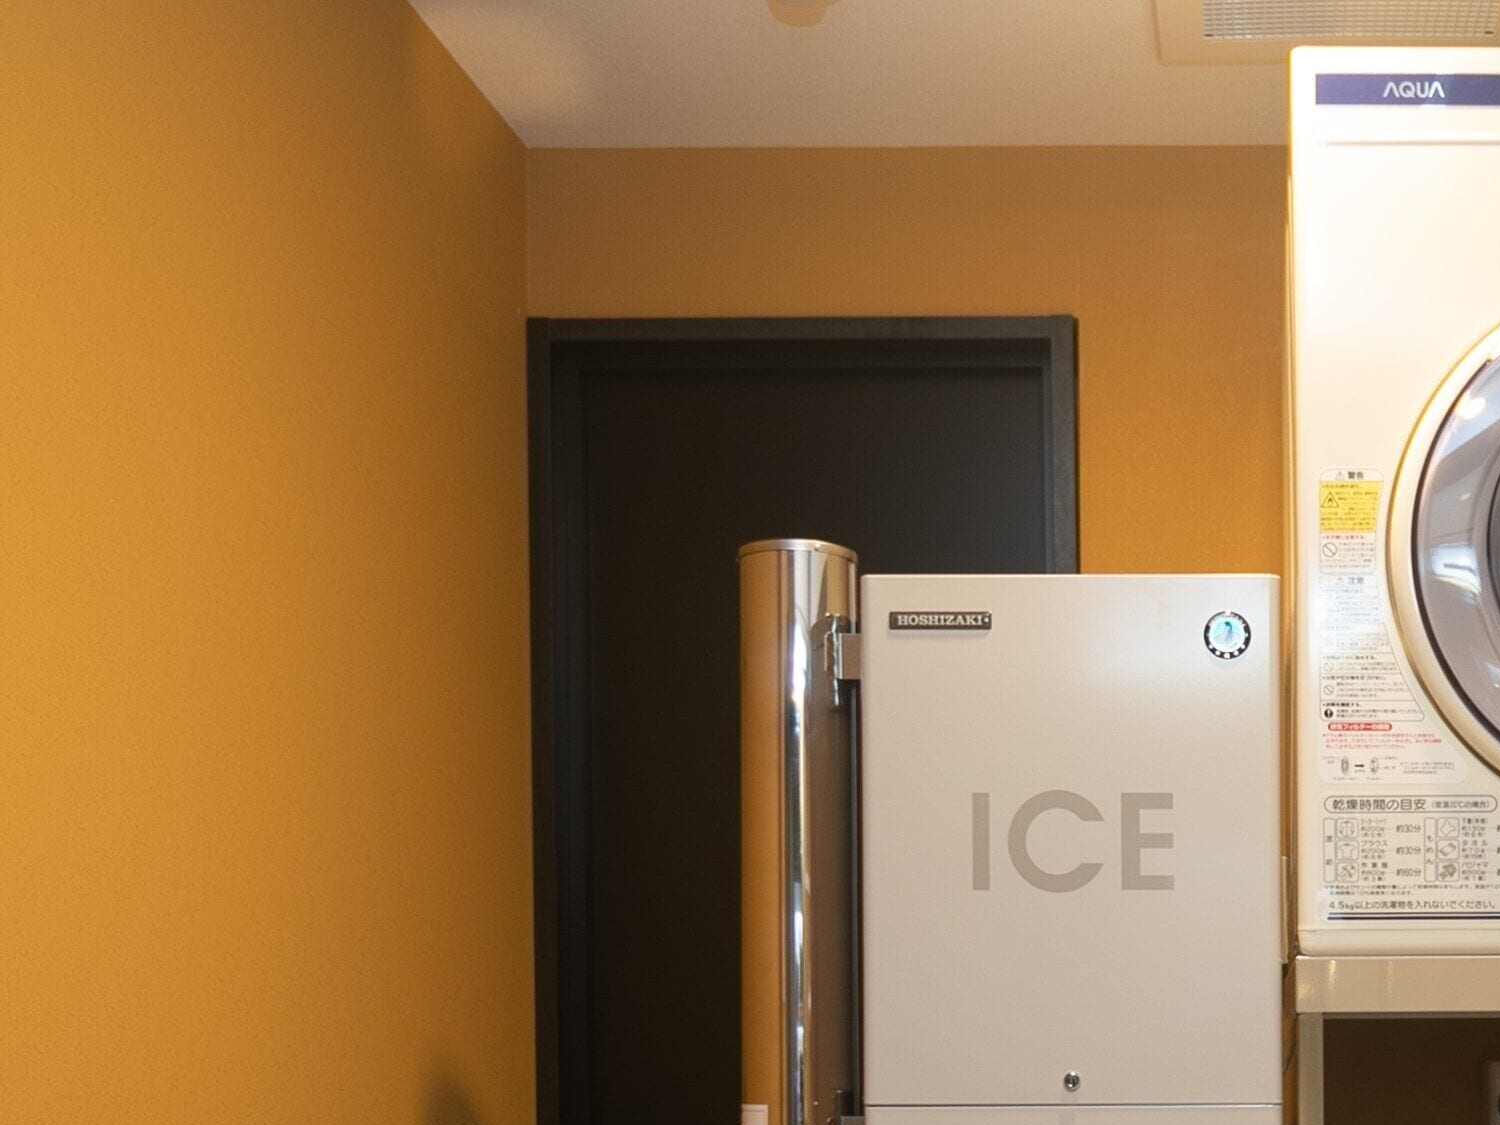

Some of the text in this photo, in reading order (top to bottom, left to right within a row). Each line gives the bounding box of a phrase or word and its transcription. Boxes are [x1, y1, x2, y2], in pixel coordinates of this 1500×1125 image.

[1383, 81, 1446, 98] AQUA
[897, 614, 983, 626] HOSHIZAKI
[1332, 799, 1426, 811] 乾燥時間の目安
[972, 790, 1175, 893] ICE
